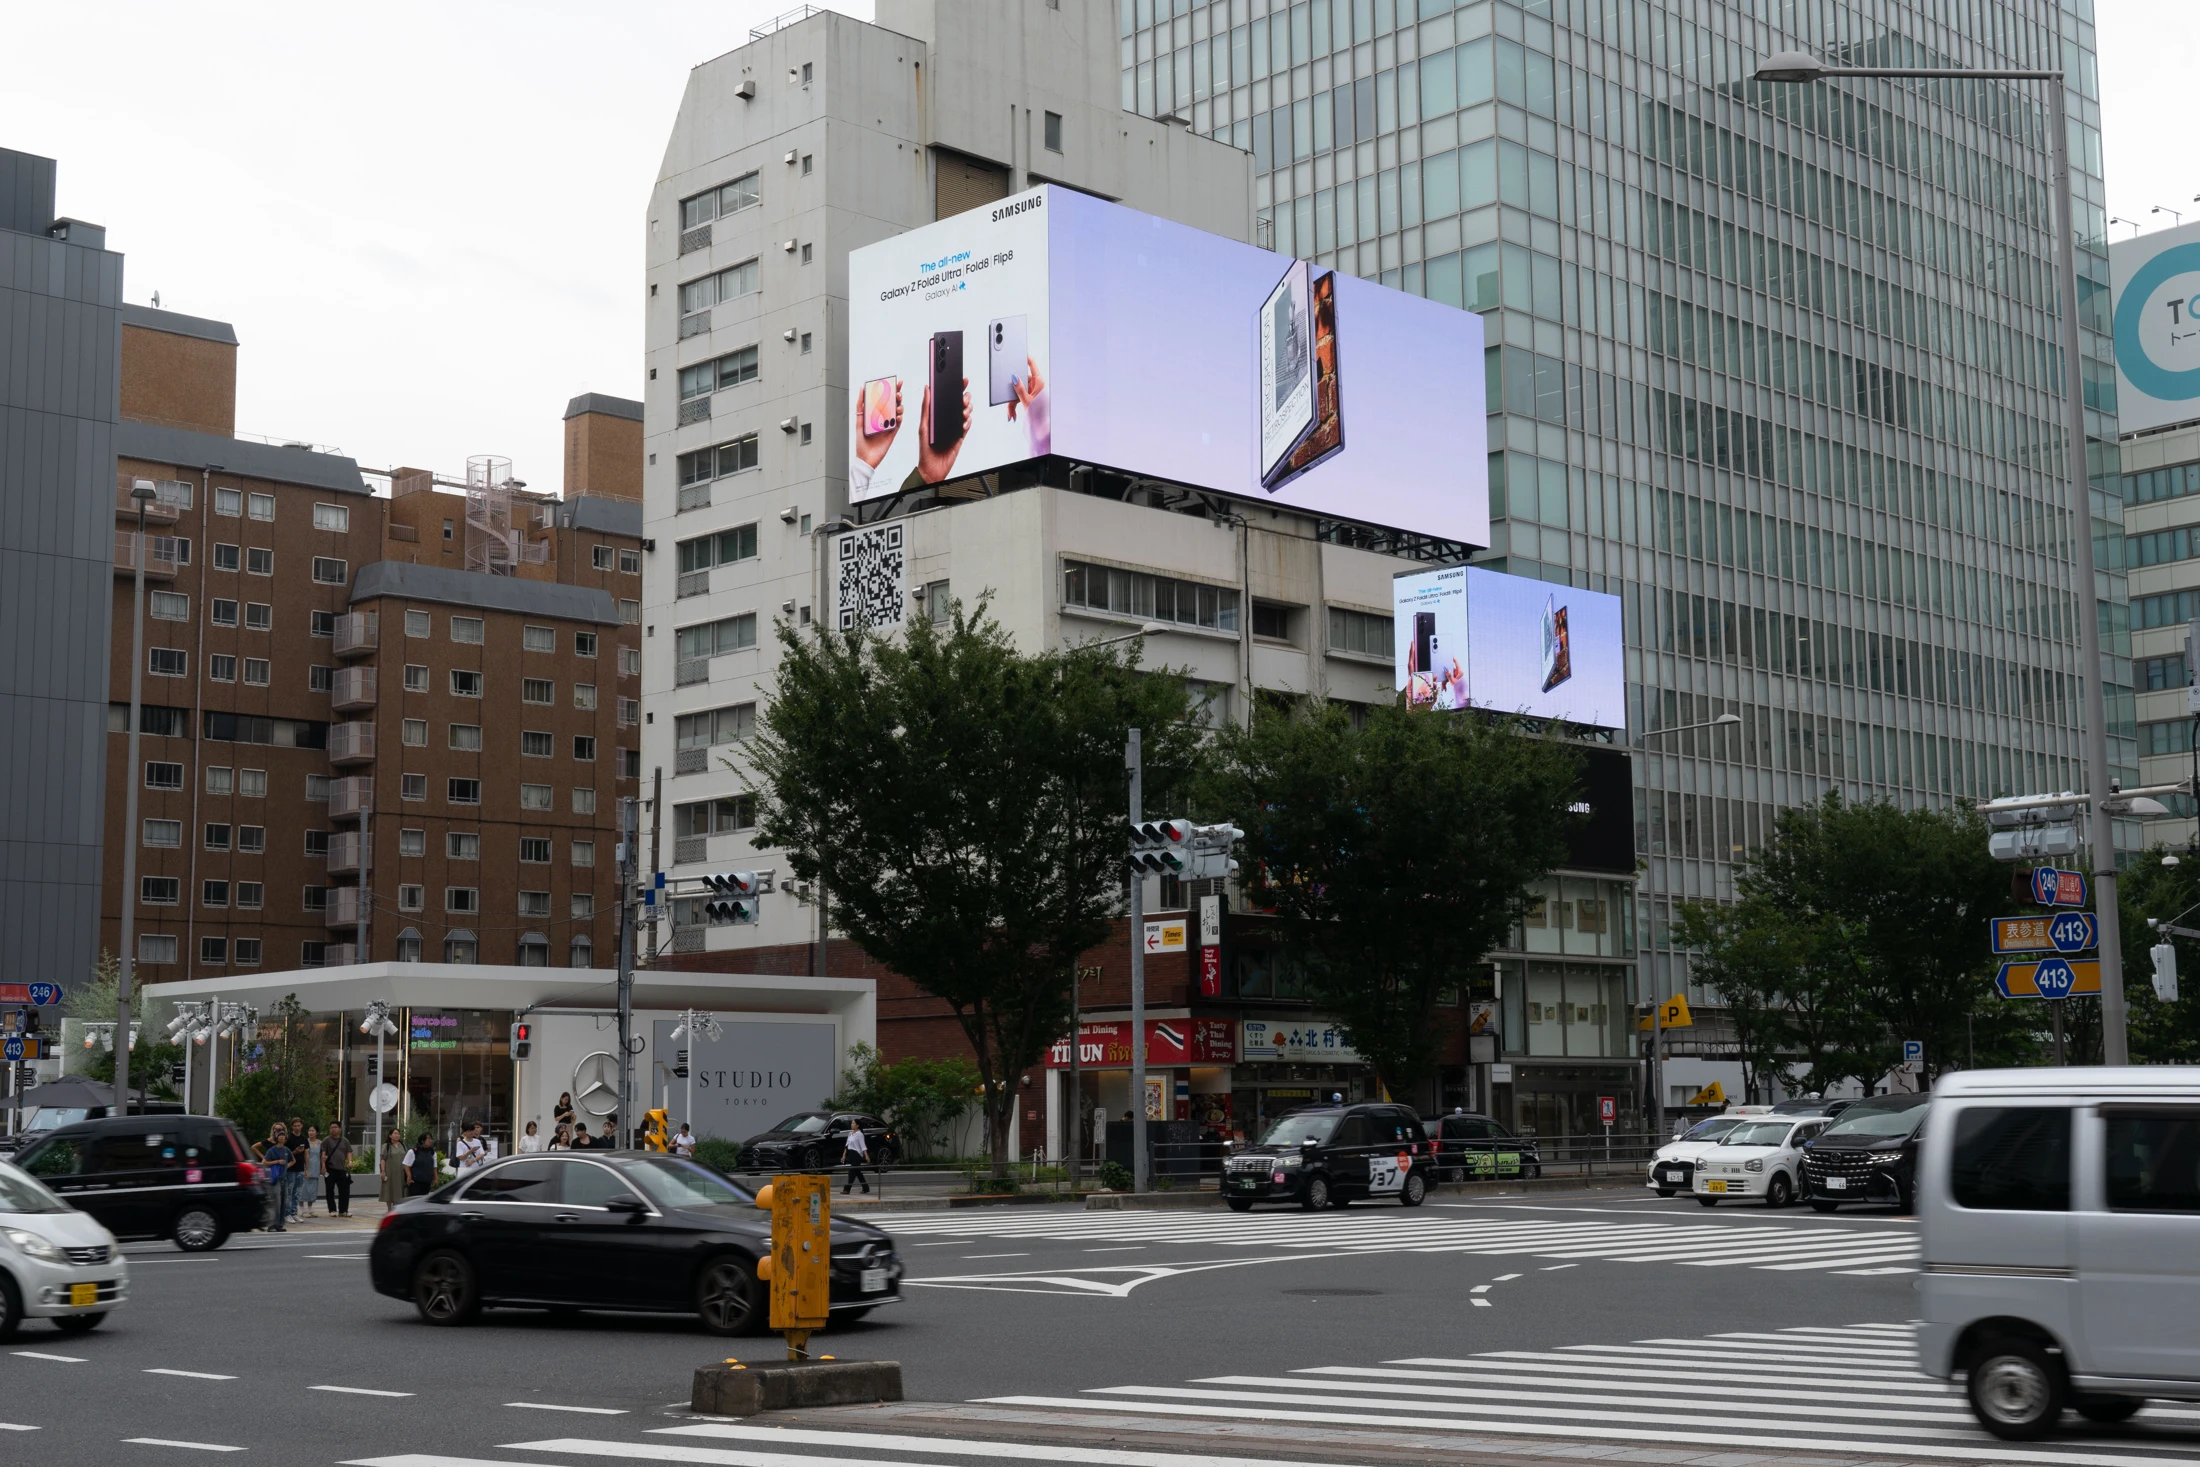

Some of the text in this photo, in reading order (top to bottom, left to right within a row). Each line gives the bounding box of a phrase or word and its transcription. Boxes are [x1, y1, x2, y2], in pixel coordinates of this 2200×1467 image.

[992, 195, 1042, 222] SAMSUNG
[920, 250, 971, 274] The all-new
[880, 250, 1014, 301] Galaxy Z Fold8 Ultra Fold8 Flip8
[925, 284, 958, 301] Galaxy AI
[1437, 570, 1464, 580] SAMSUNG
[2042, 873, 2056, 891] 246
[645, 906, 665, 915] 時差式
[2006, 921, 2045, 938] 表参道
[2055, 921, 2084, 942] 413
[2039, 968, 2068, 988] 413
[32, 986, 50, 998] 246
[1668, 1006, 1679, 1022] P
[1078, 1025, 1118, 1035] hai Dining
[1209, 1022, 1227, 1030] Tasty
[6, 1043, 21, 1055] 413
[1209, 1040, 1232, 1049] Dining
[1906, 1043, 1920, 1059] P
[699, 1070, 792, 1088] STUDIO
[725, 1098, 767, 1106] TOKYO
[1708, 1089, 1715, 1099] P
